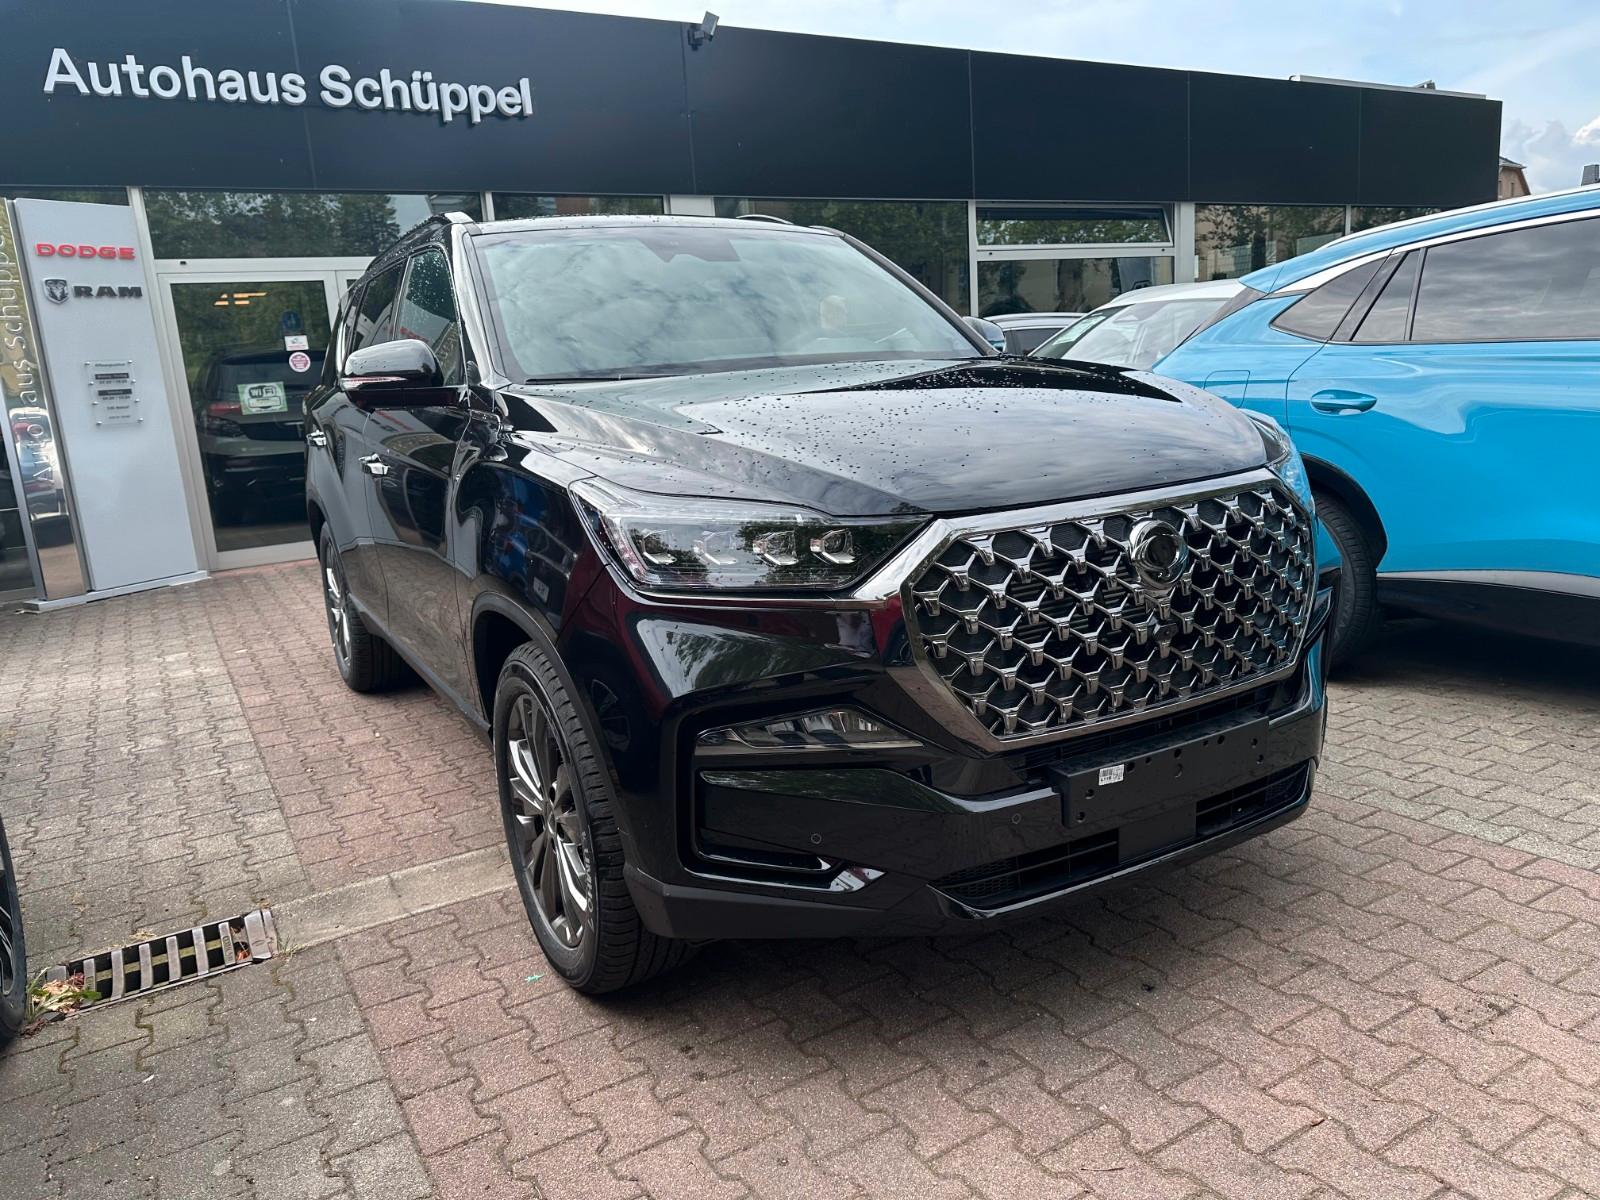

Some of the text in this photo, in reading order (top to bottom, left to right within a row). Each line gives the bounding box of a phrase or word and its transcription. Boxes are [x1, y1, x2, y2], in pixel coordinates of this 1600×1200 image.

[44, 48, 533, 124] Autohaus Schüppel
[36, 243, 136, 260] DODGE
[73, 285, 143, 298] RAM
